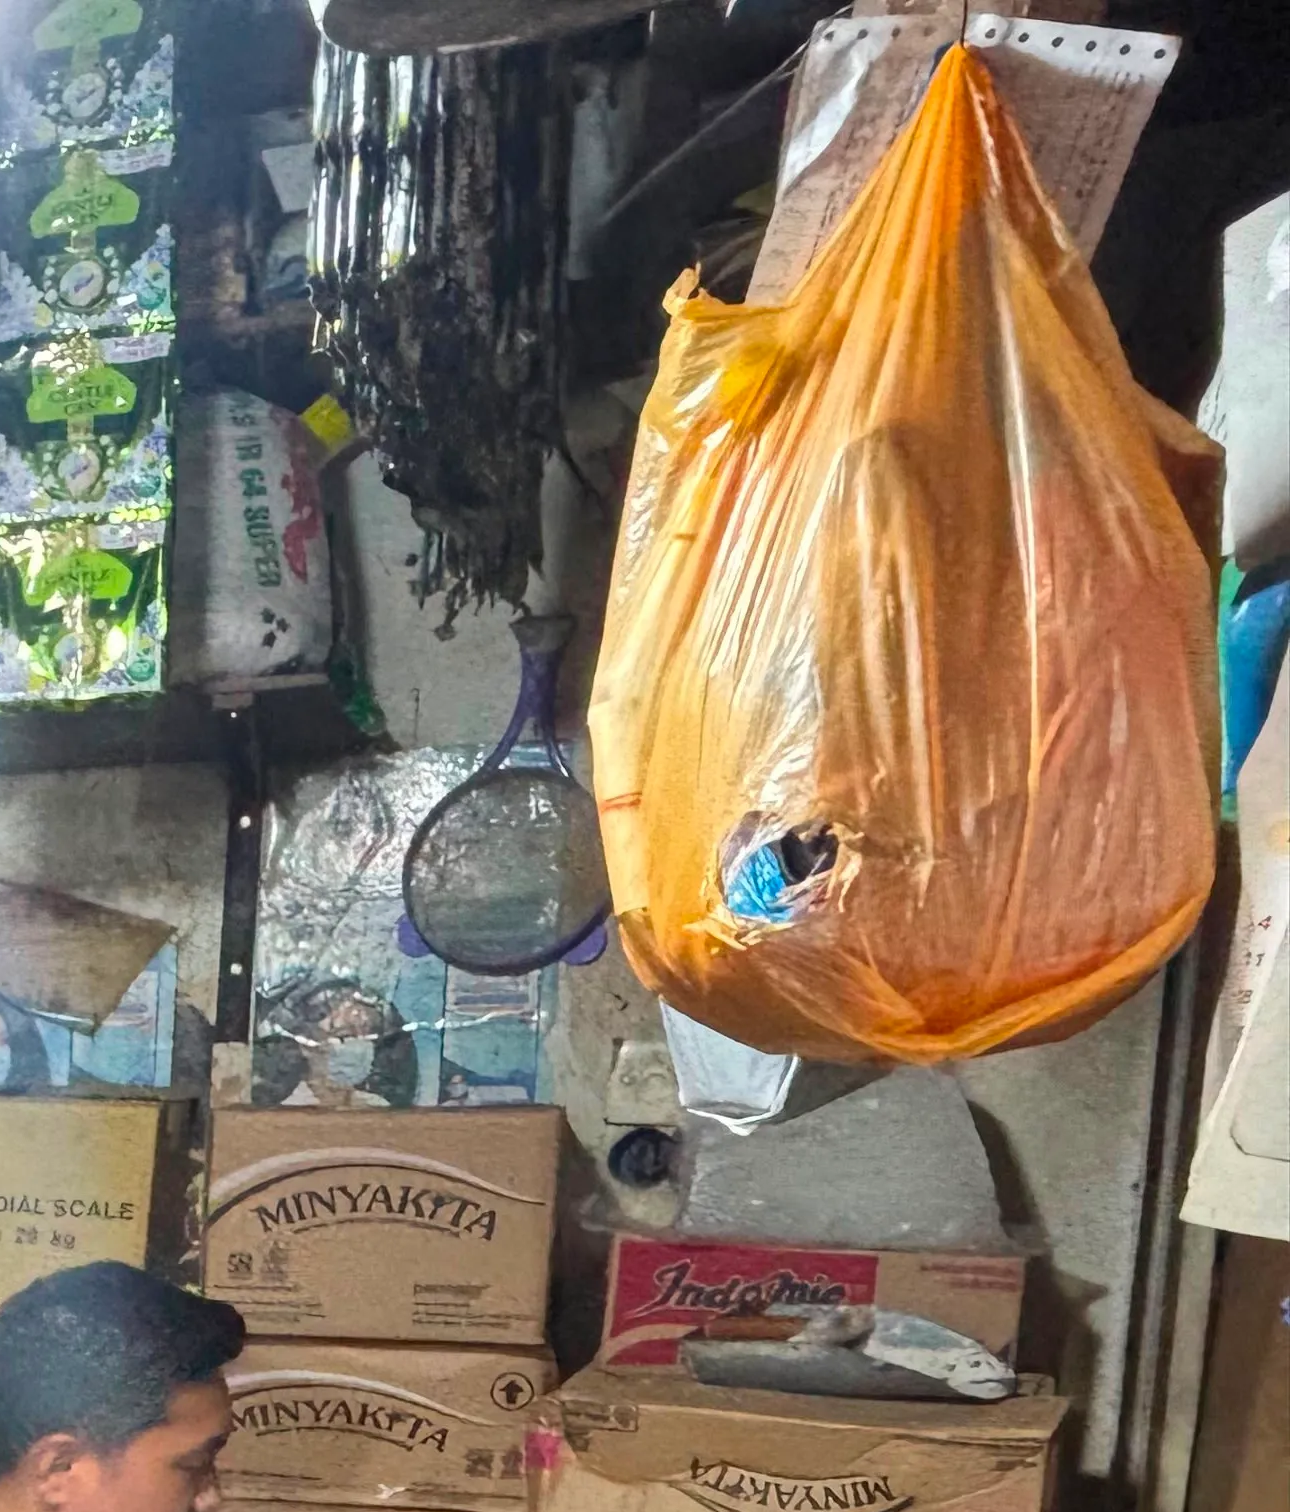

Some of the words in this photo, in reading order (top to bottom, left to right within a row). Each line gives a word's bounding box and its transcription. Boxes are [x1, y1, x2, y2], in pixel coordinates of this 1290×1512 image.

[243, 505, 282, 587] SUPER
[52, 1199, 135, 1221] SCALE
[250, 1184, 498, 1242] MINYAKITA
[231, 1399, 450, 1453] MINYAKITA
[689, 1456, 897, 1512] MINYAKITA
